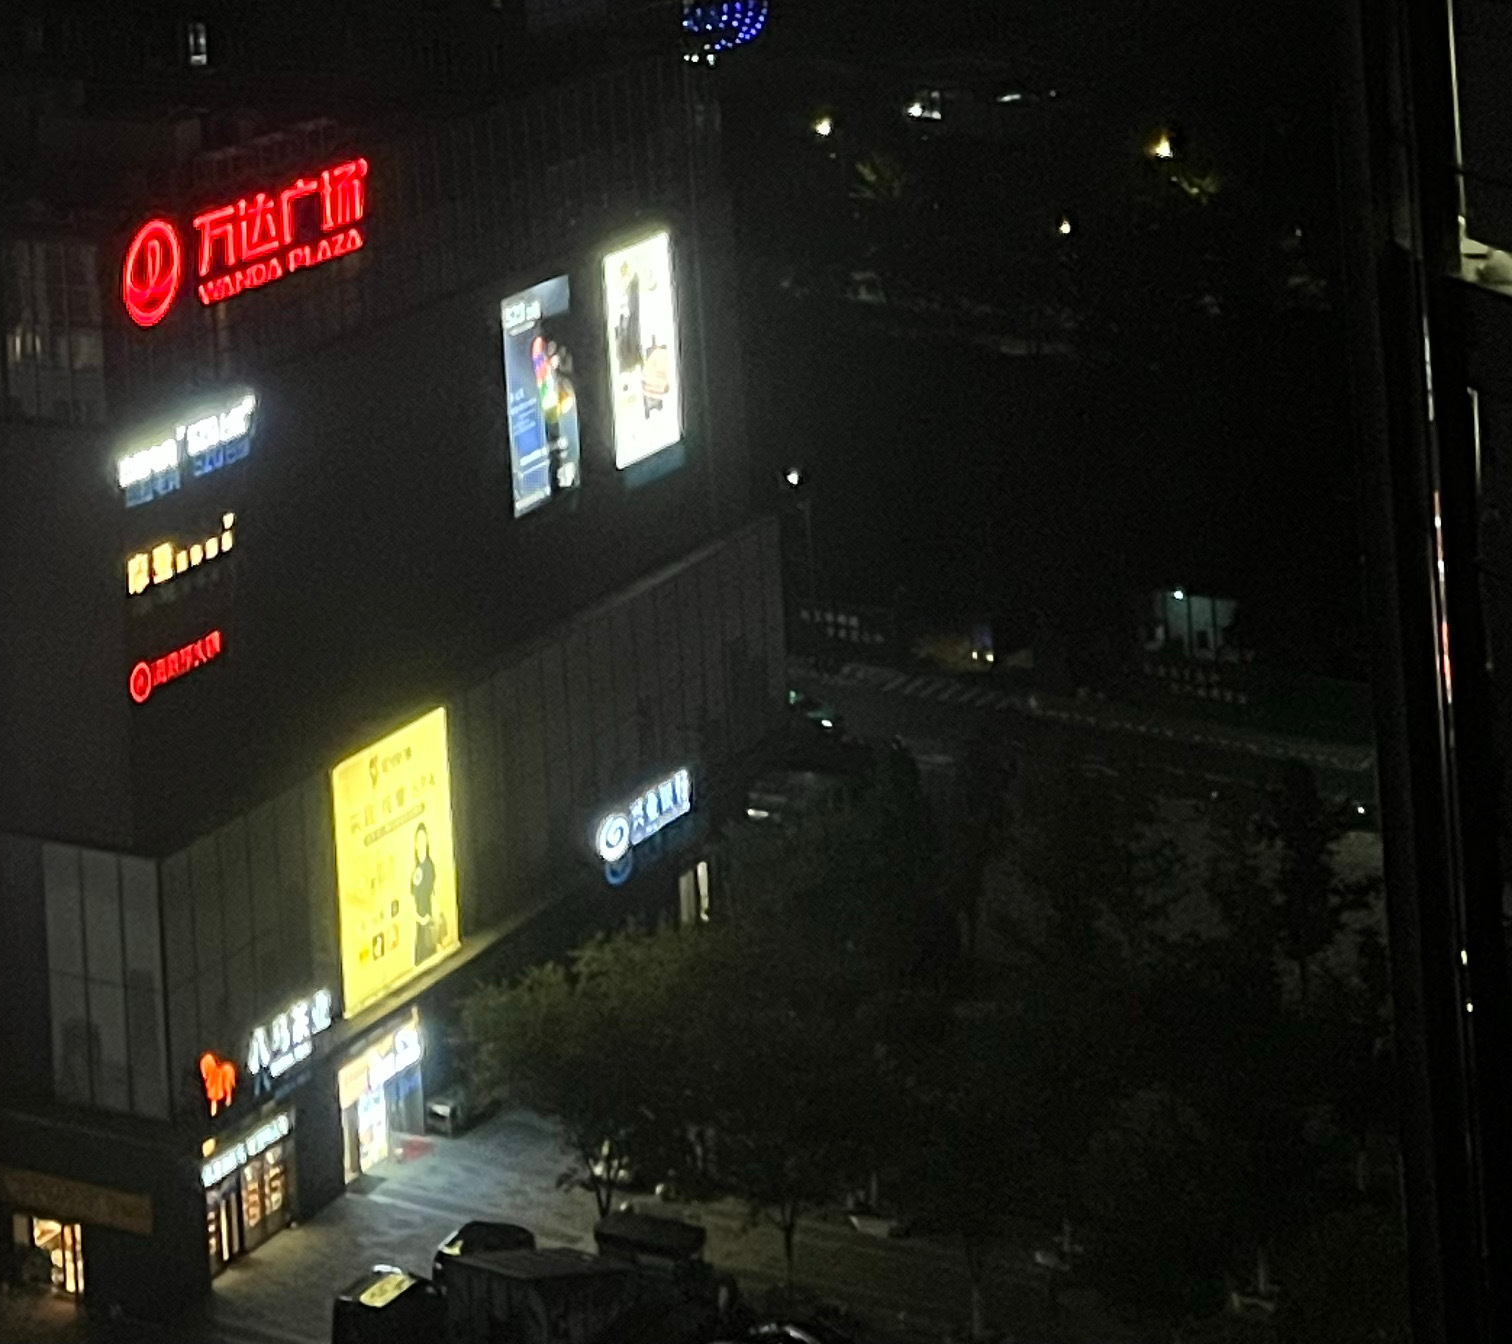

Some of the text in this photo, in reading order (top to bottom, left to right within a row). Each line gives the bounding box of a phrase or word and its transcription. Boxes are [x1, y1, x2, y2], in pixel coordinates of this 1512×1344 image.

[192, 157, 368, 277] 万达广场
[198, 228, 364, 305] WANDA PLAZA
